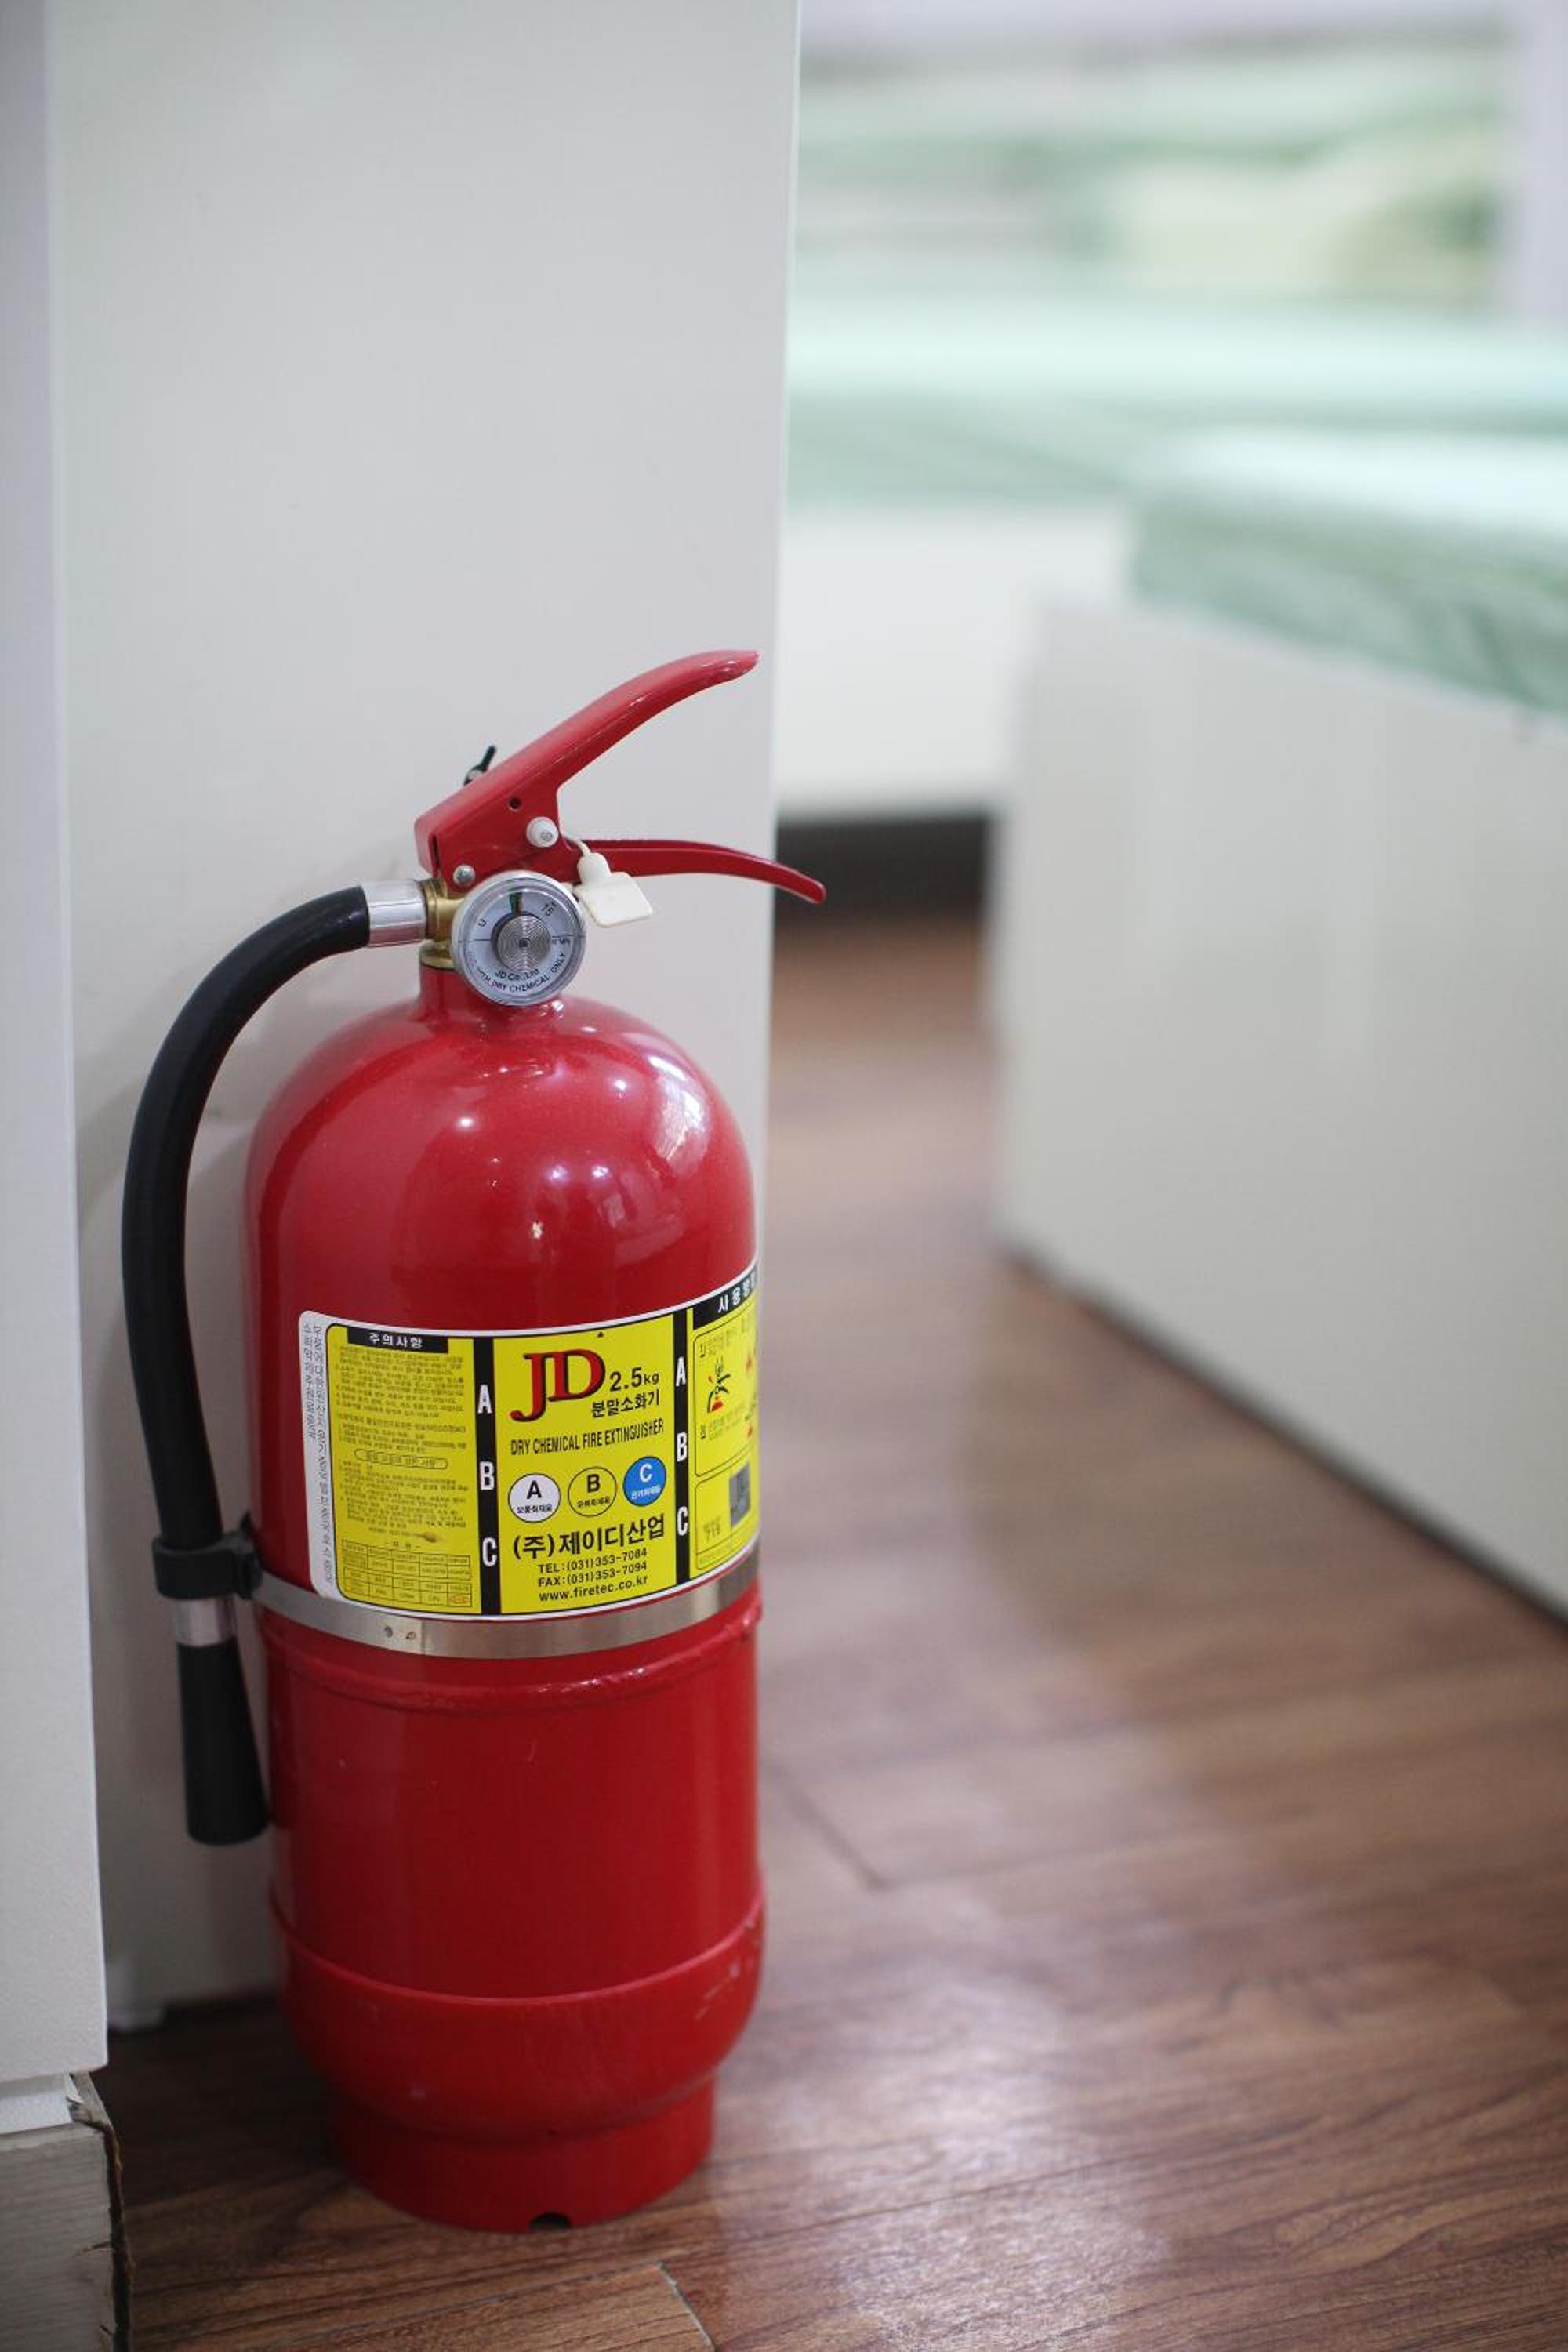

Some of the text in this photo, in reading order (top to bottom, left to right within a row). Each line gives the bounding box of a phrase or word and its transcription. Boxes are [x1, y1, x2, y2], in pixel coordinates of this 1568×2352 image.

[369, 1333, 423, 1349] 주의사항
[510, 1349, 606, 1423] JD
[610, 1367, 659, 1392] 2.5kg
[674, 1357, 687, 1387] A
[477, 1384, 492, 1414] A
[592, 1389, 659, 1418] 분말소화기
[510, 1418, 664, 1456] DRY CHEMICAL FIRE EXTINGUISHER
[677, 1432, 688, 1462] B
[479, 1461, 495, 1490] B
[586, 1474, 601, 1494] B
[639, 1463, 653, 1483] C
[526, 1480, 543, 1500] A
[677, 1506, 688, 1536] C
[482, 1537, 498, 1567] C
[539, 1576, 648, 1602] www.firetec.co.kr
